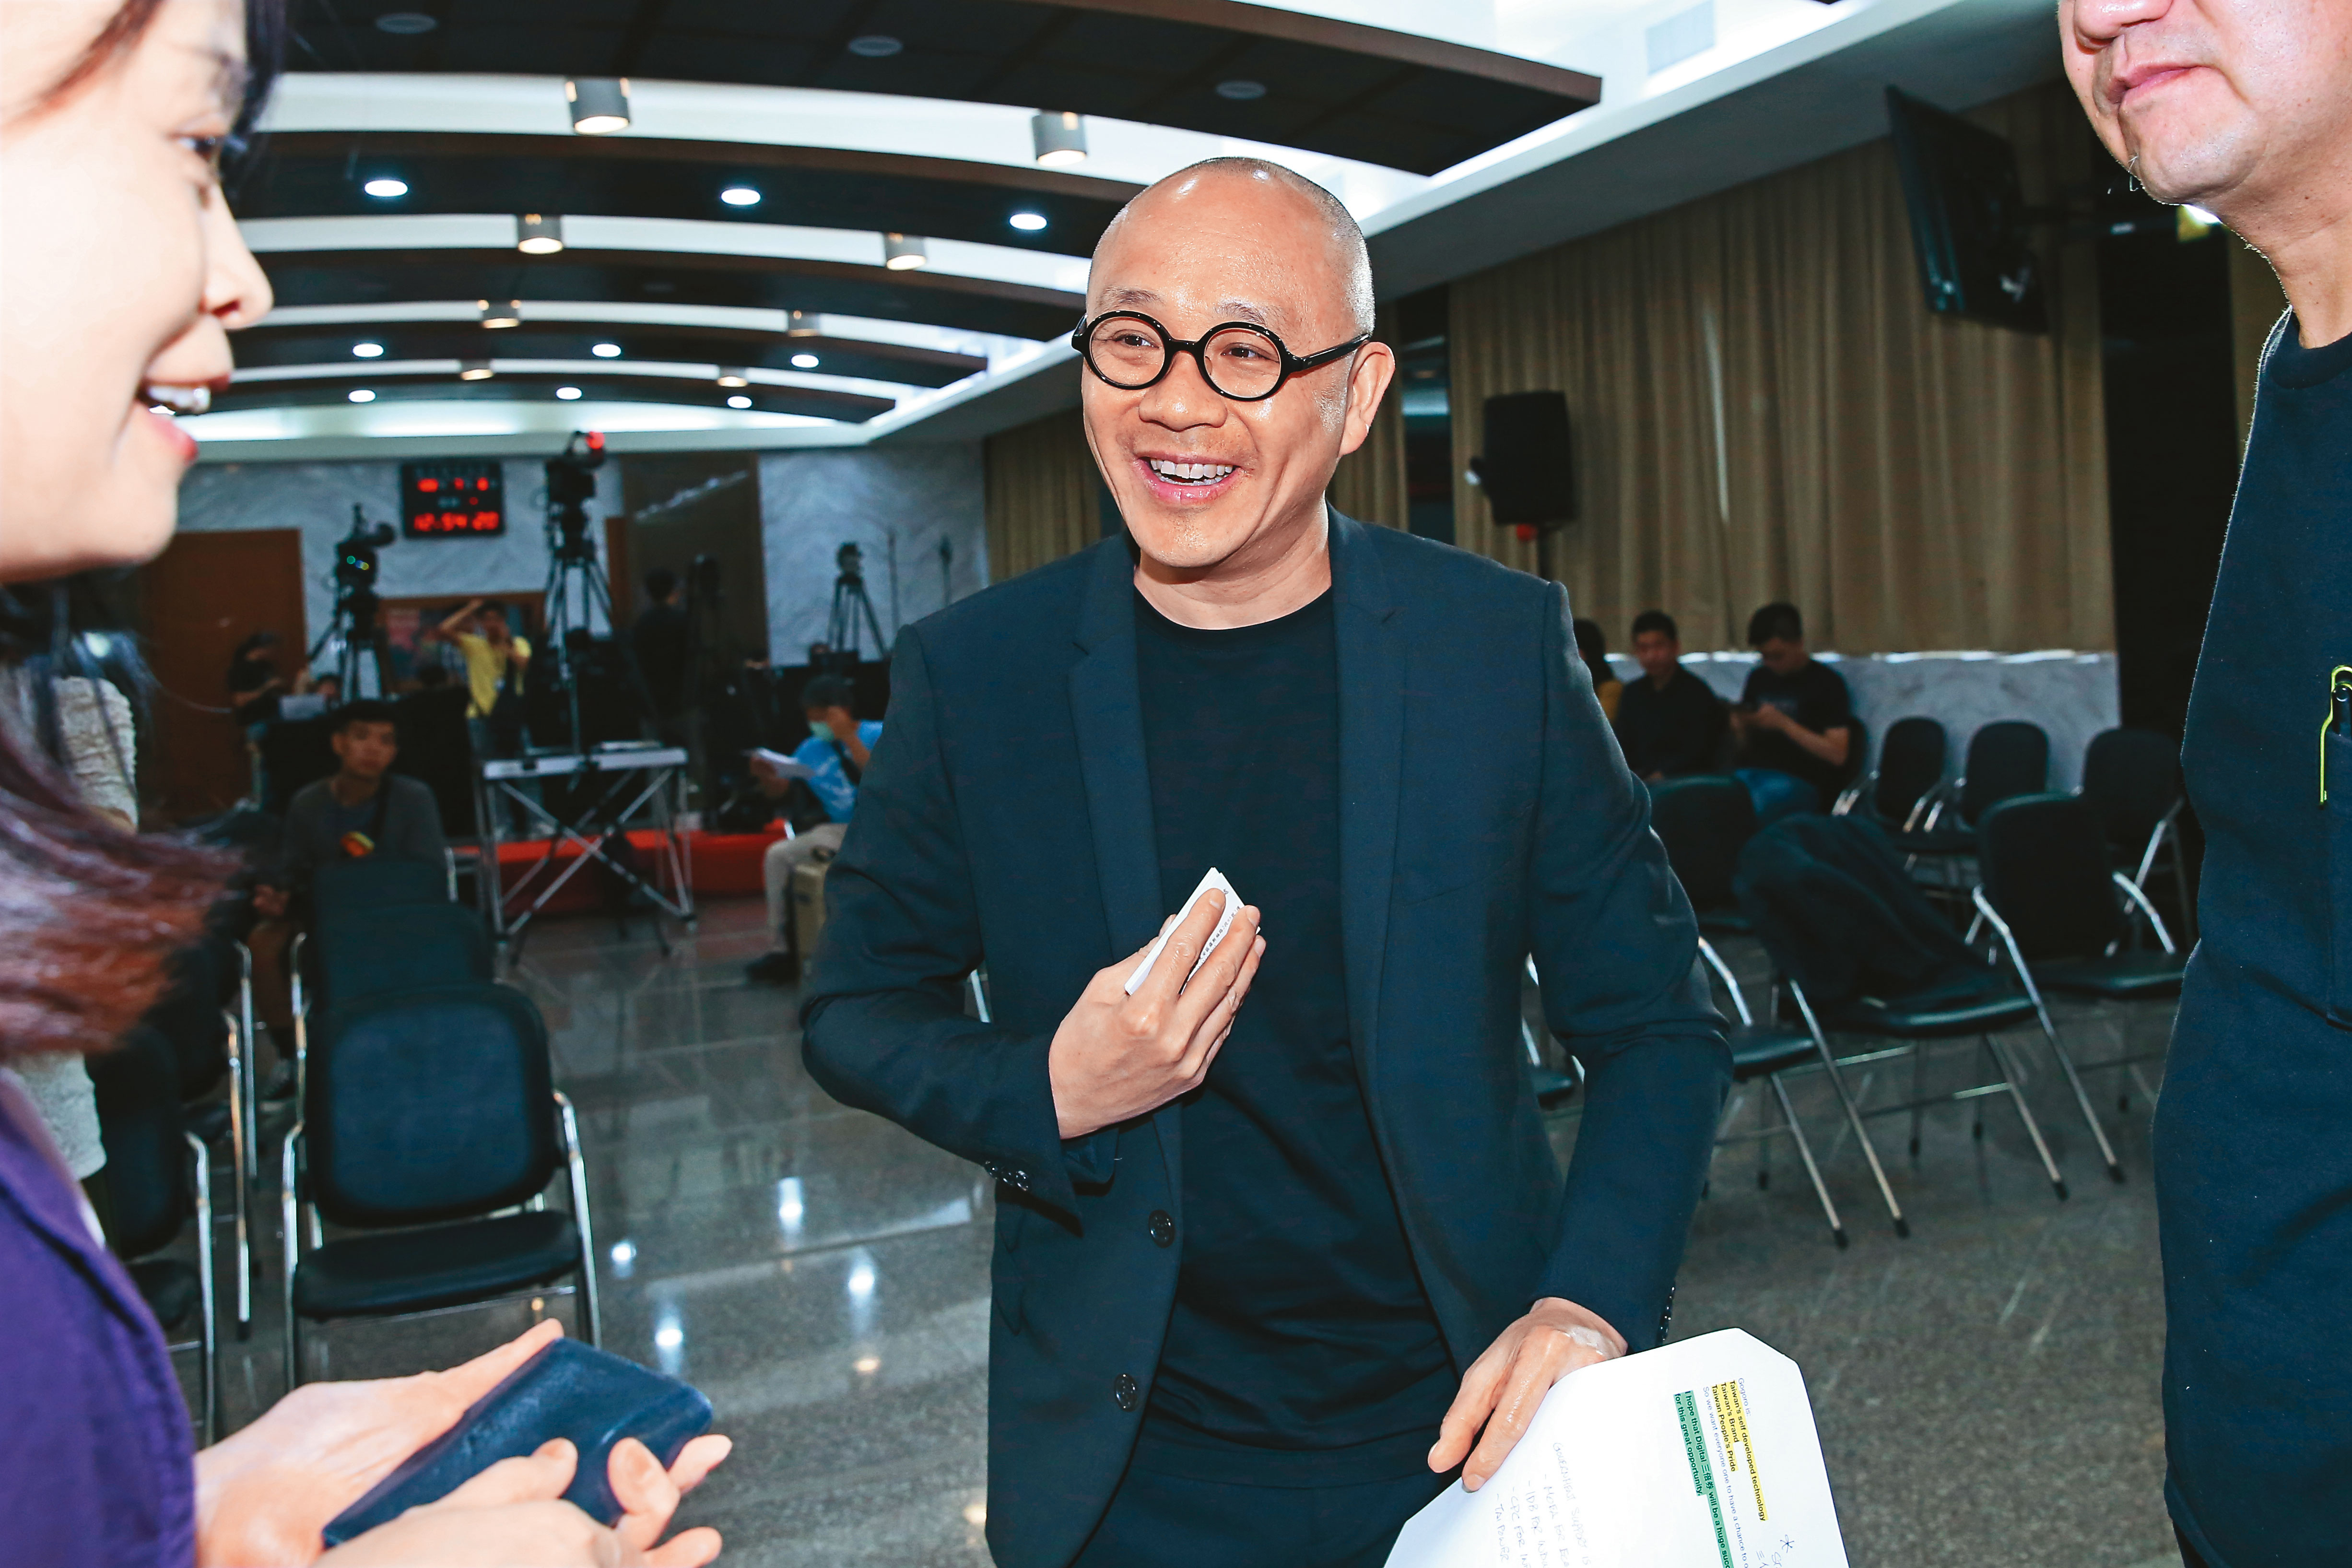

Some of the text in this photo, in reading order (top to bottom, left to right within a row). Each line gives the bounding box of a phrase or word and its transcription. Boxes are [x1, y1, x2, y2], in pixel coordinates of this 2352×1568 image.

[1738, 1378, 1749, 1406] Gogoro
[1678, 1406, 1686, 1422] this
[1686, 1395, 1694, 1415] hope
[1721, 1382, 1740, 1443] Taiwan's Brand
[1681, 1424, 1692, 1446] great
[1691, 1417, 1700, 1435] that
[1712, 1384, 1736, 1472] Taiwan People's Pride
[1695, 1436, 1707, 1462] Digital
[1729, 1380, 1765, 1521] Taiwan's self developed technology
[1687, 1447, 1703, 1496] opportunity.
[1701, 1464, 1714, 1489] 三倍券
[1703, 1386, 1709, 1397] So
[1706, 1399, 1712, 1410] we
[1710, 1412, 1718, 1430] want
[1714, 1432, 1726, 1467] everyone
[1726, 1485, 1731, 1493] to
[1734, 1523, 1745, 1551] chance
[1741, 1553, 1747, 1561] to
[1708, 1491, 1717, 1506] will
[1712, 1508, 1718, 1518] be
[1531, 1516, 1543, 1535] FOR
[1514, 1526, 1525, 1548] FOR
[1717, 1527, 1726, 1548] huge
